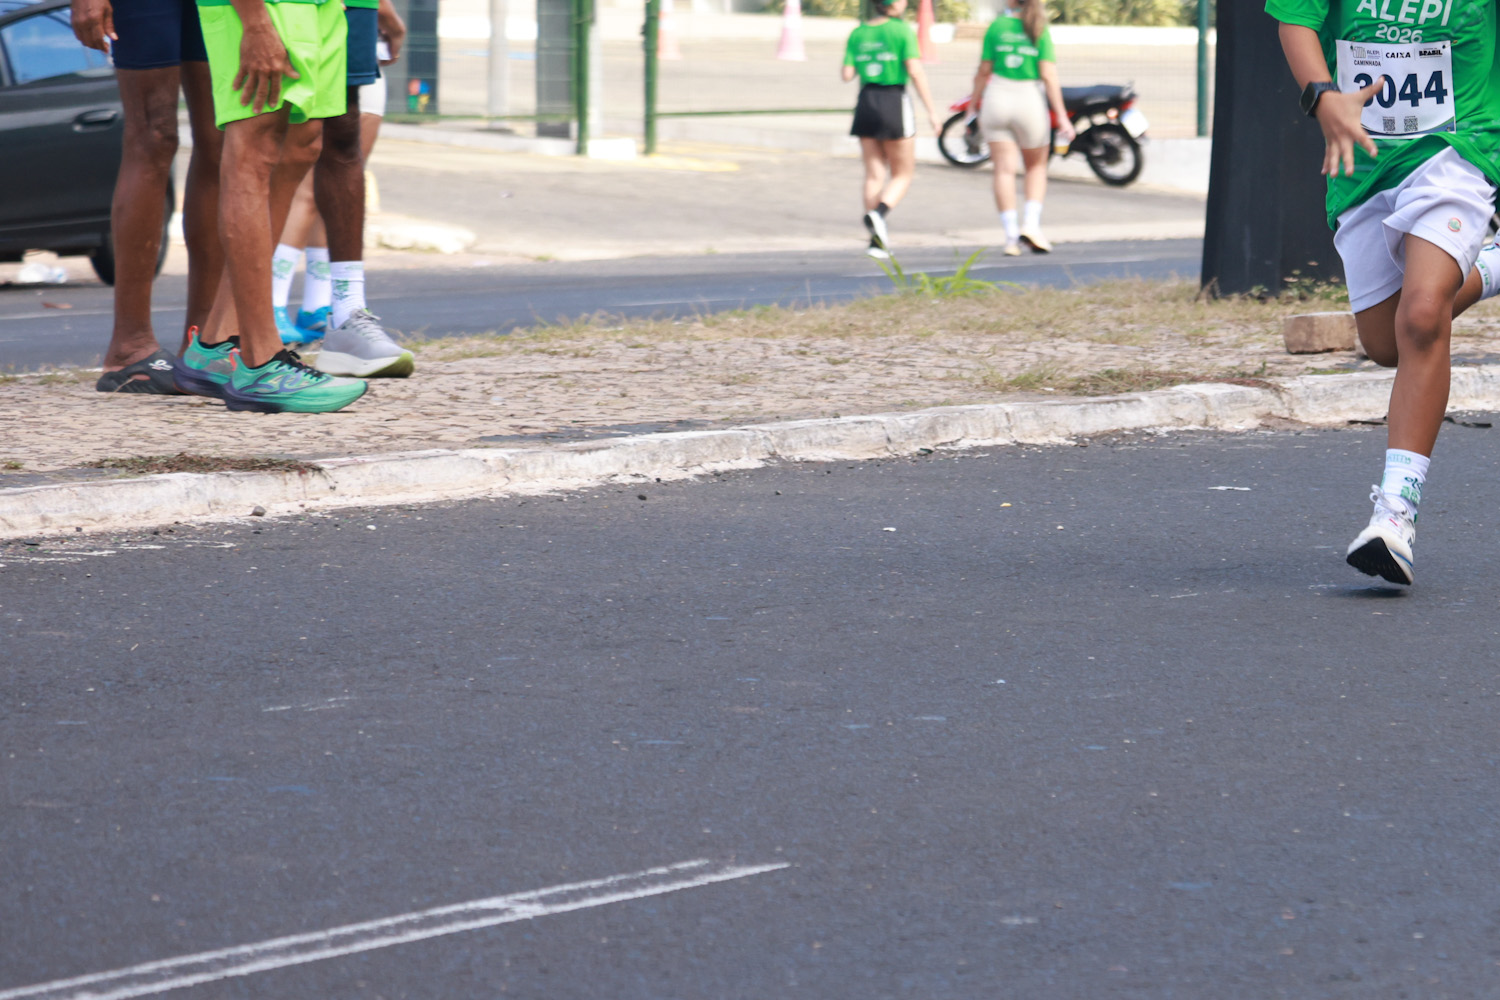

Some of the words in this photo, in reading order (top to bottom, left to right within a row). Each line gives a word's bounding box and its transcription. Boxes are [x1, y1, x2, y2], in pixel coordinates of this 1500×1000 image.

[1375, 23, 1423, 44] 2026
[1385, 51, 1412, 59] CAIXA
[1353, 59, 1382, 67] CAMINHADA
[1353, 69, 1449, 109] 3044
